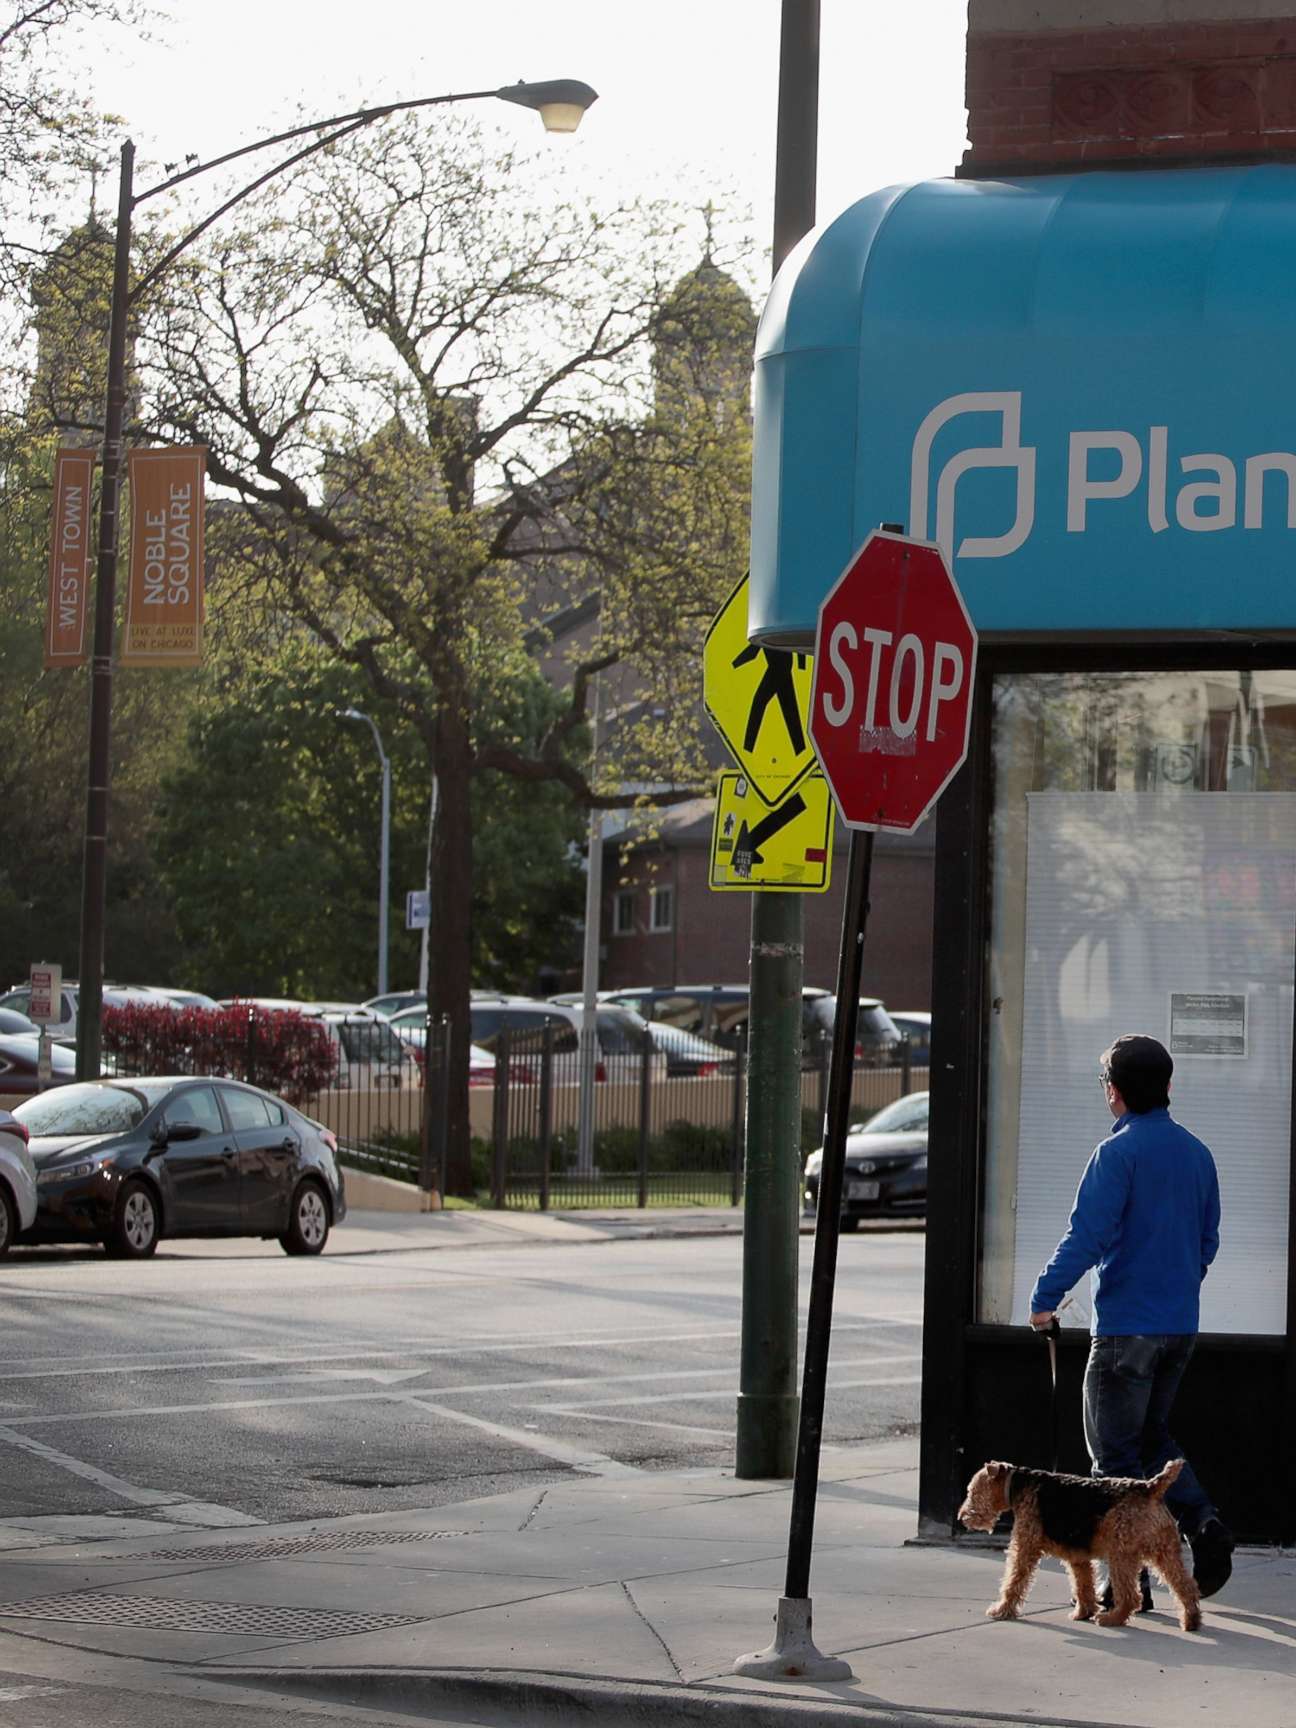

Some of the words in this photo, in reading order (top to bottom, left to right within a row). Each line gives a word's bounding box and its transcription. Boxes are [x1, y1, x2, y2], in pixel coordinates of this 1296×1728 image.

[63, 486, 83, 553] TOWN
[143, 508, 166, 605] NOBLE
[167, 483, 191, 605] SQUARE
[59, 562, 79, 627] WEST
[822, 620, 964, 742] STOP
